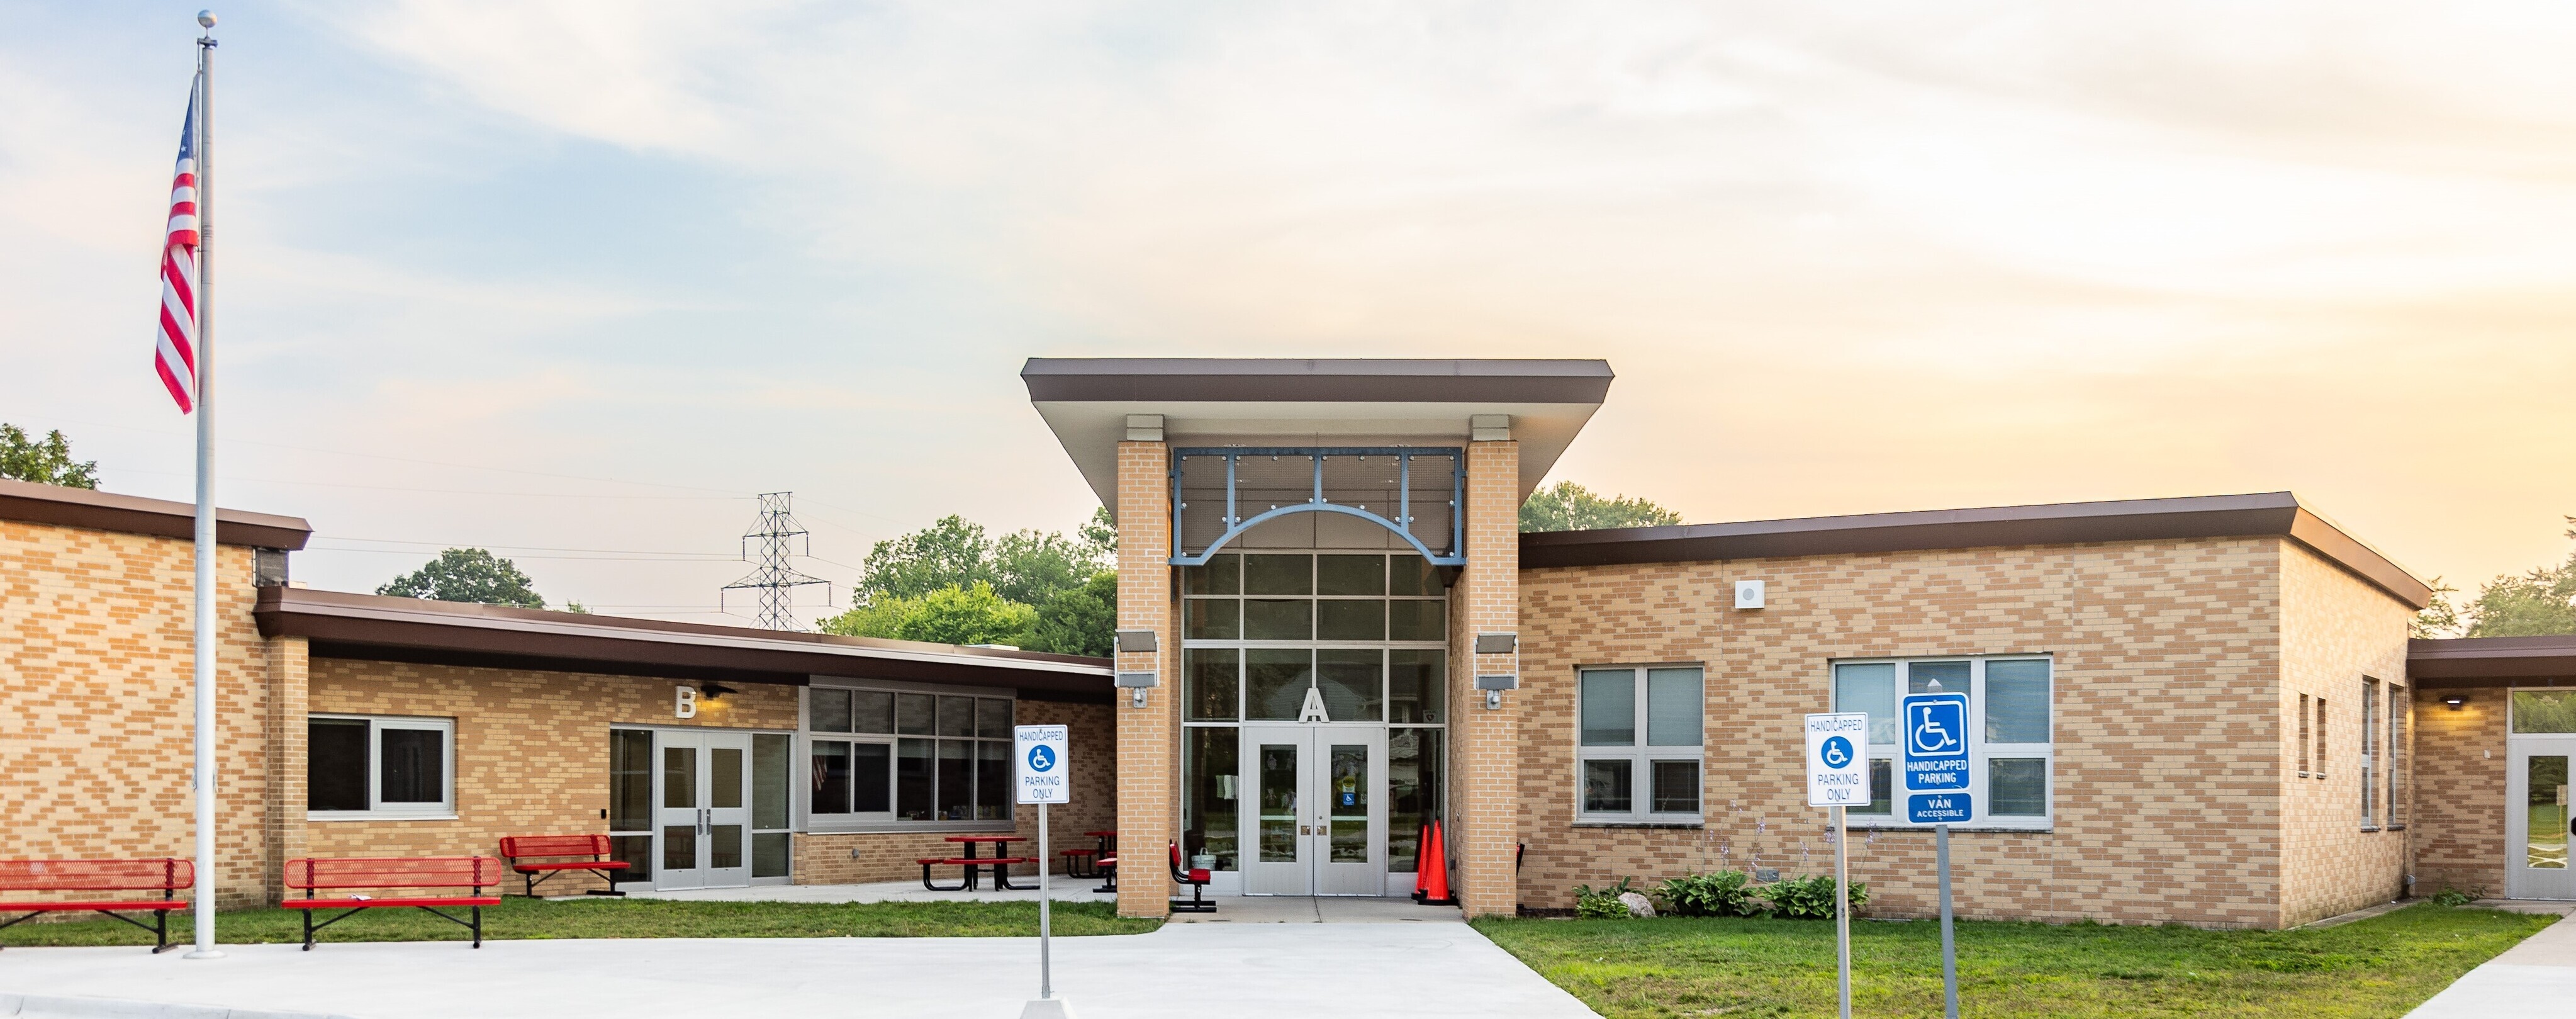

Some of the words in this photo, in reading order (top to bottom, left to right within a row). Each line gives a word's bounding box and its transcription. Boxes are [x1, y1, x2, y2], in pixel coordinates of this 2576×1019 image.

[675, 685, 697, 718] B
[1298, 687, 1330, 723] A
[1810, 719, 1863, 732] HANDICAPPED
[1019, 731, 1063, 741] HANDICAPPED
[1907, 759, 1968, 772] HANDICAPPED
[1025, 776, 1060, 786] PARKING
[1818, 774, 1859, 785] PARKING
[1918, 772, 1957, 784] PARKING
[1033, 789, 1053, 799] ONLY
[1827, 789, 1851, 800] ONLY
[1927, 799, 1952, 809] VAN
[1917, 809, 1964, 818] ACCESSIBLE
